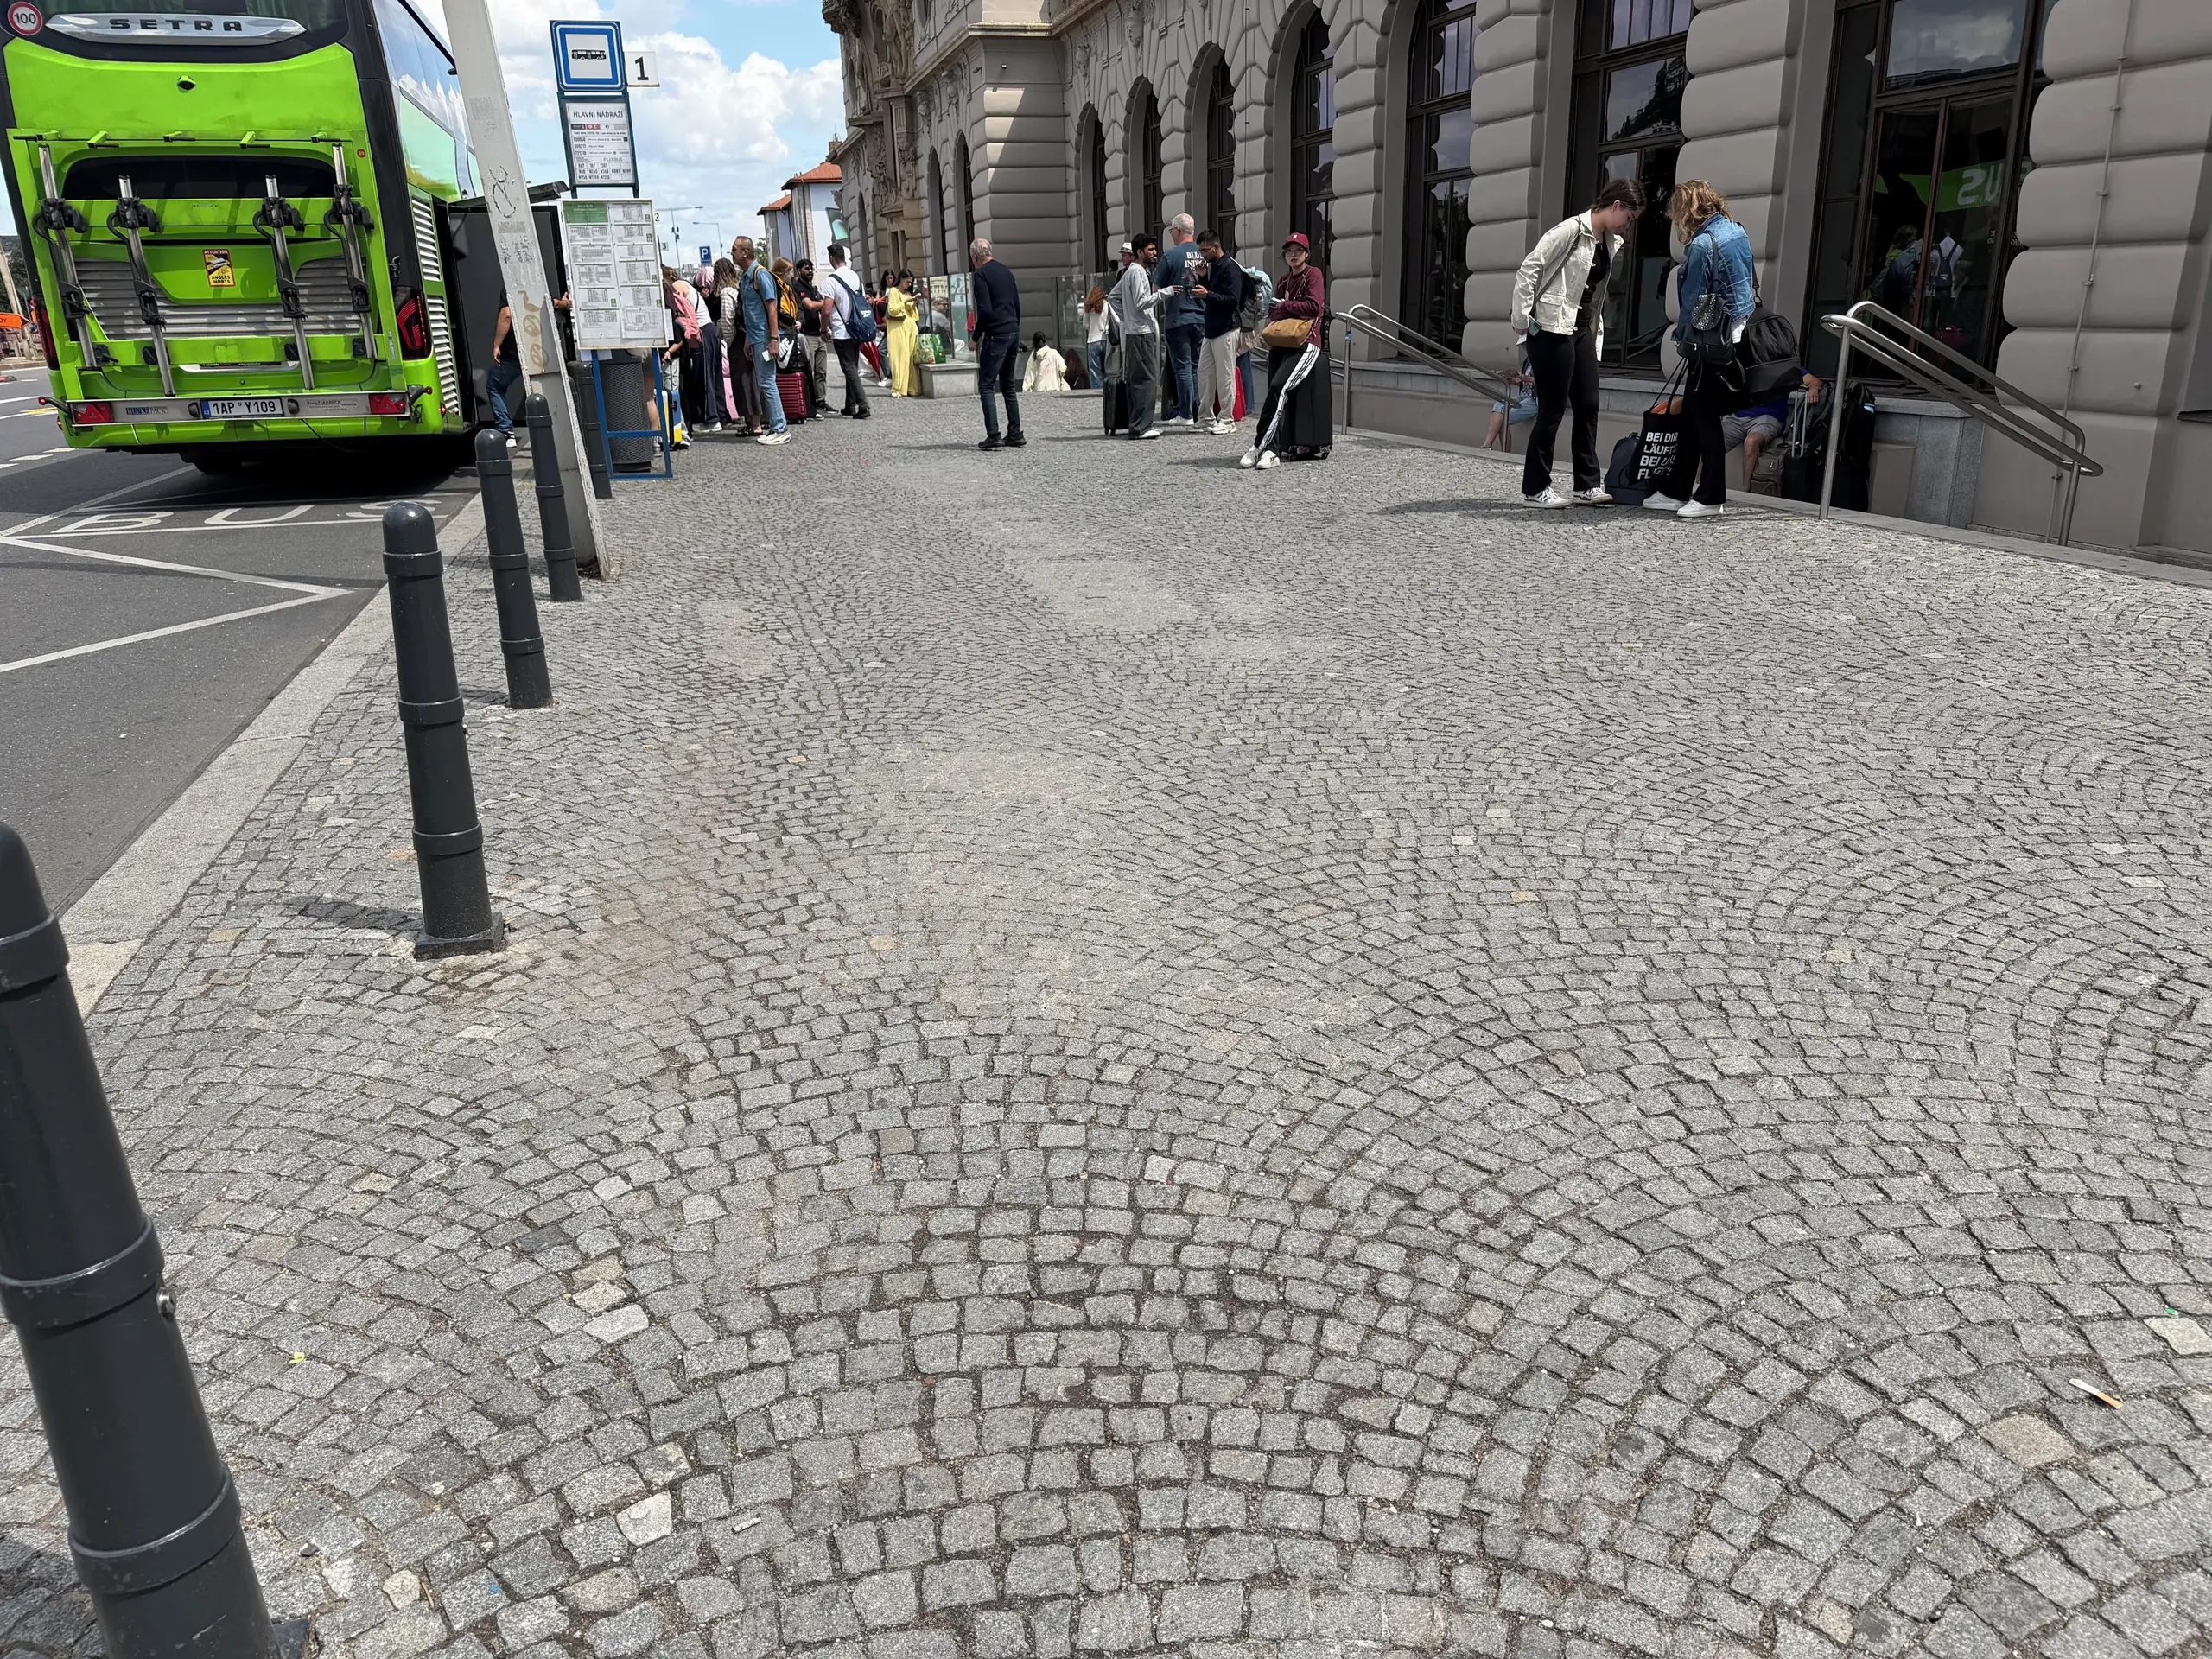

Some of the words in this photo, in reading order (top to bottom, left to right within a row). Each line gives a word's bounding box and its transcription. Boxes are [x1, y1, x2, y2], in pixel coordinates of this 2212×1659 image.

[14, 12, 36, 24] 100
[110, 18, 243, 32] SETRA
[634, 56, 649, 81] 1
[701, 248, 709, 259] P
[213, 402, 234, 415] 1AP
[244, 400, 276, 413] Y109
[1646, 432, 1663, 442] BEI
[1664, 432, 1678, 442] DIR
[1639, 455, 1661, 467] BEI
